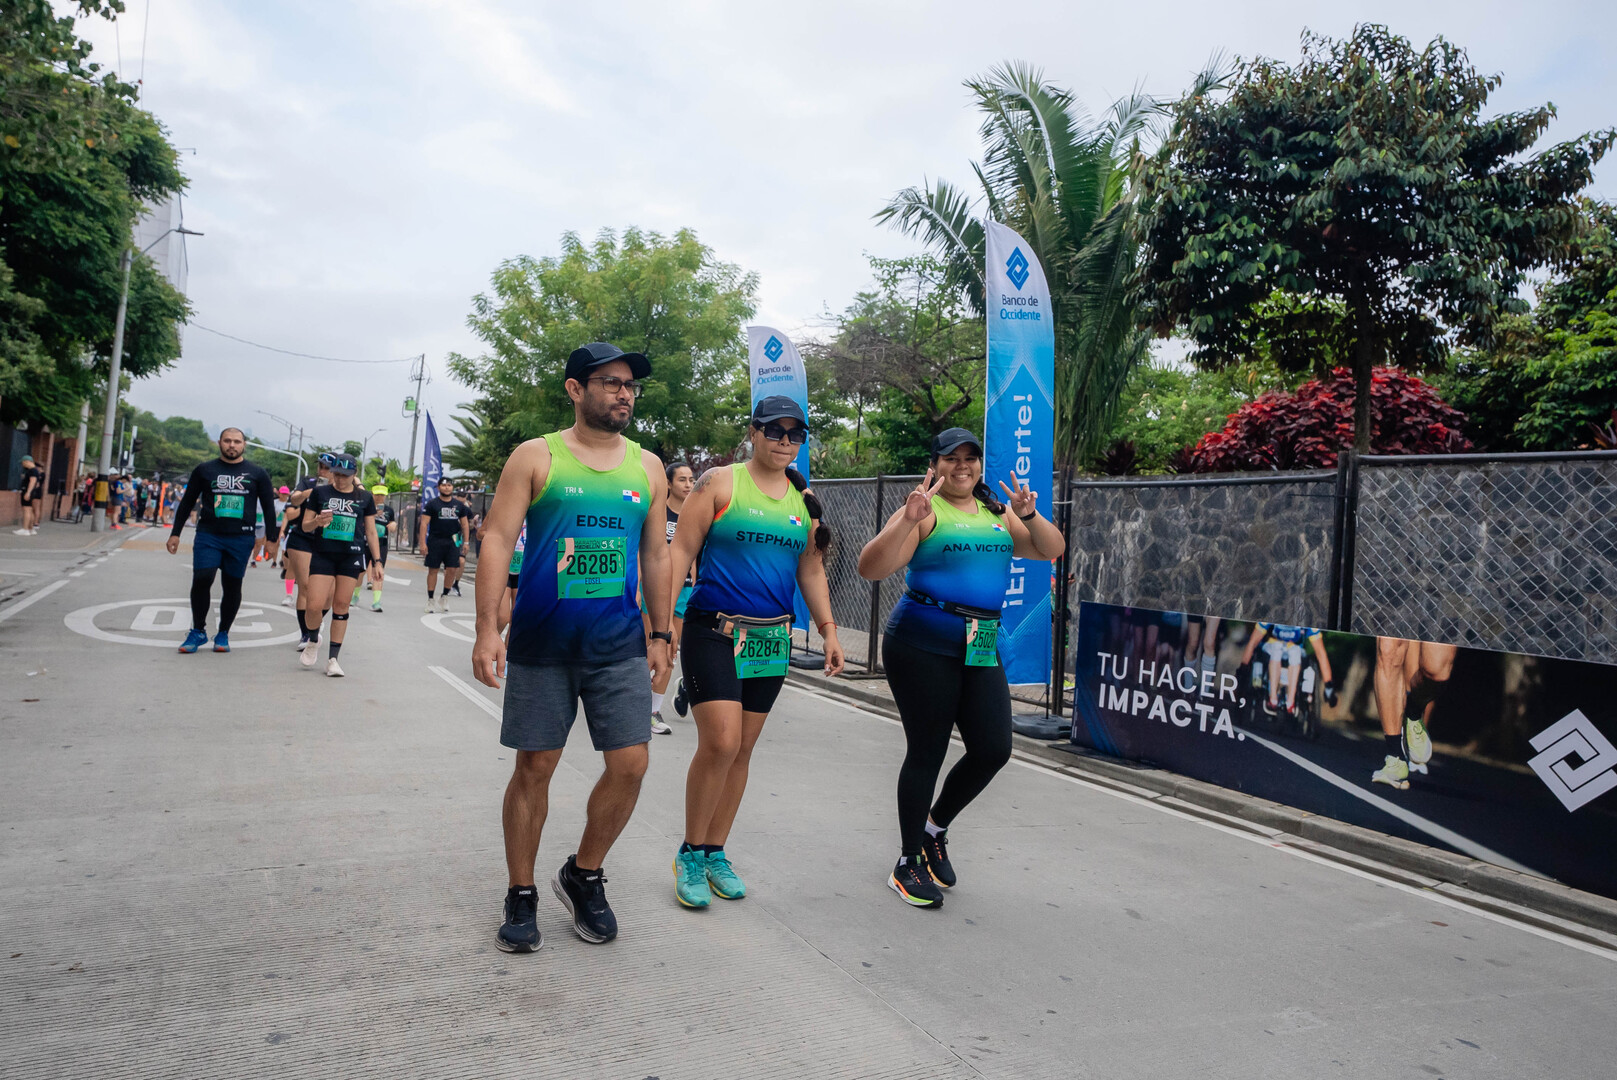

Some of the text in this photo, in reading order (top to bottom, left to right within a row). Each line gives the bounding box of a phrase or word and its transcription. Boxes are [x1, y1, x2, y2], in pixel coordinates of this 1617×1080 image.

[1001, 294, 1039, 307] Banco de
[1000, 308, 1041, 321] Occidente
[758, 364, 792, 376] Banco de
[757, 374, 794, 385] Occidente
[564, 486, 577, 494] TRI
[1001, 393, 1033, 609] ¡Er erte!
[576, 514, 625, 530] EDSEL
[735, 530, 806, 551] STEPHANY
[942, 542, 972, 553] ANA
[566, 553, 617, 575] 26285
[584, 577, 601, 585] EDSEL
[740, 640, 780, 658] 26284
[1097, 651, 1247, 709] TU HACER,
[1098, 682, 1246, 742] IMPACTA.
